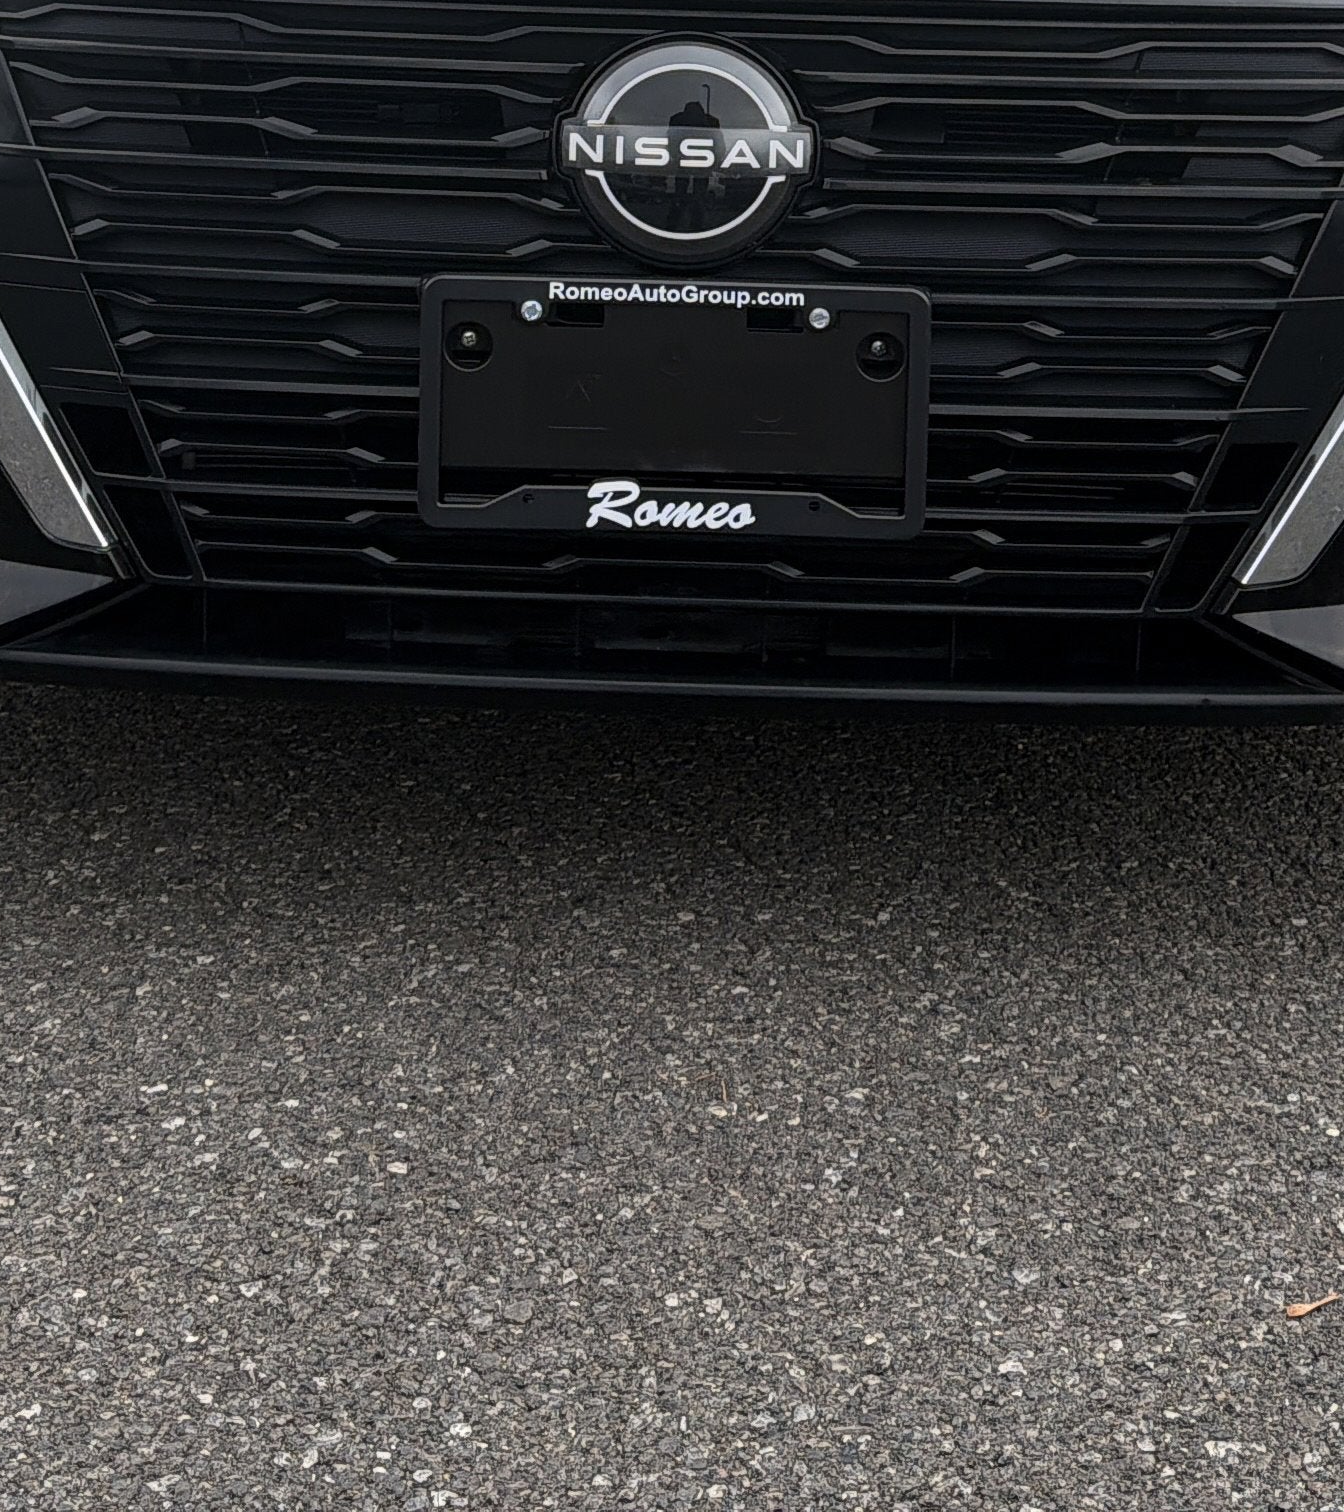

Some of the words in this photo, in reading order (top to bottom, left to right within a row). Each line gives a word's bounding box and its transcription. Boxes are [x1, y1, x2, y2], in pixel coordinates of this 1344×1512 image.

[568, 132, 805, 169] NISSAN
[549, 281, 805, 309] RomeoAutoGroup.com
[585, 480, 756, 530] Romeo
